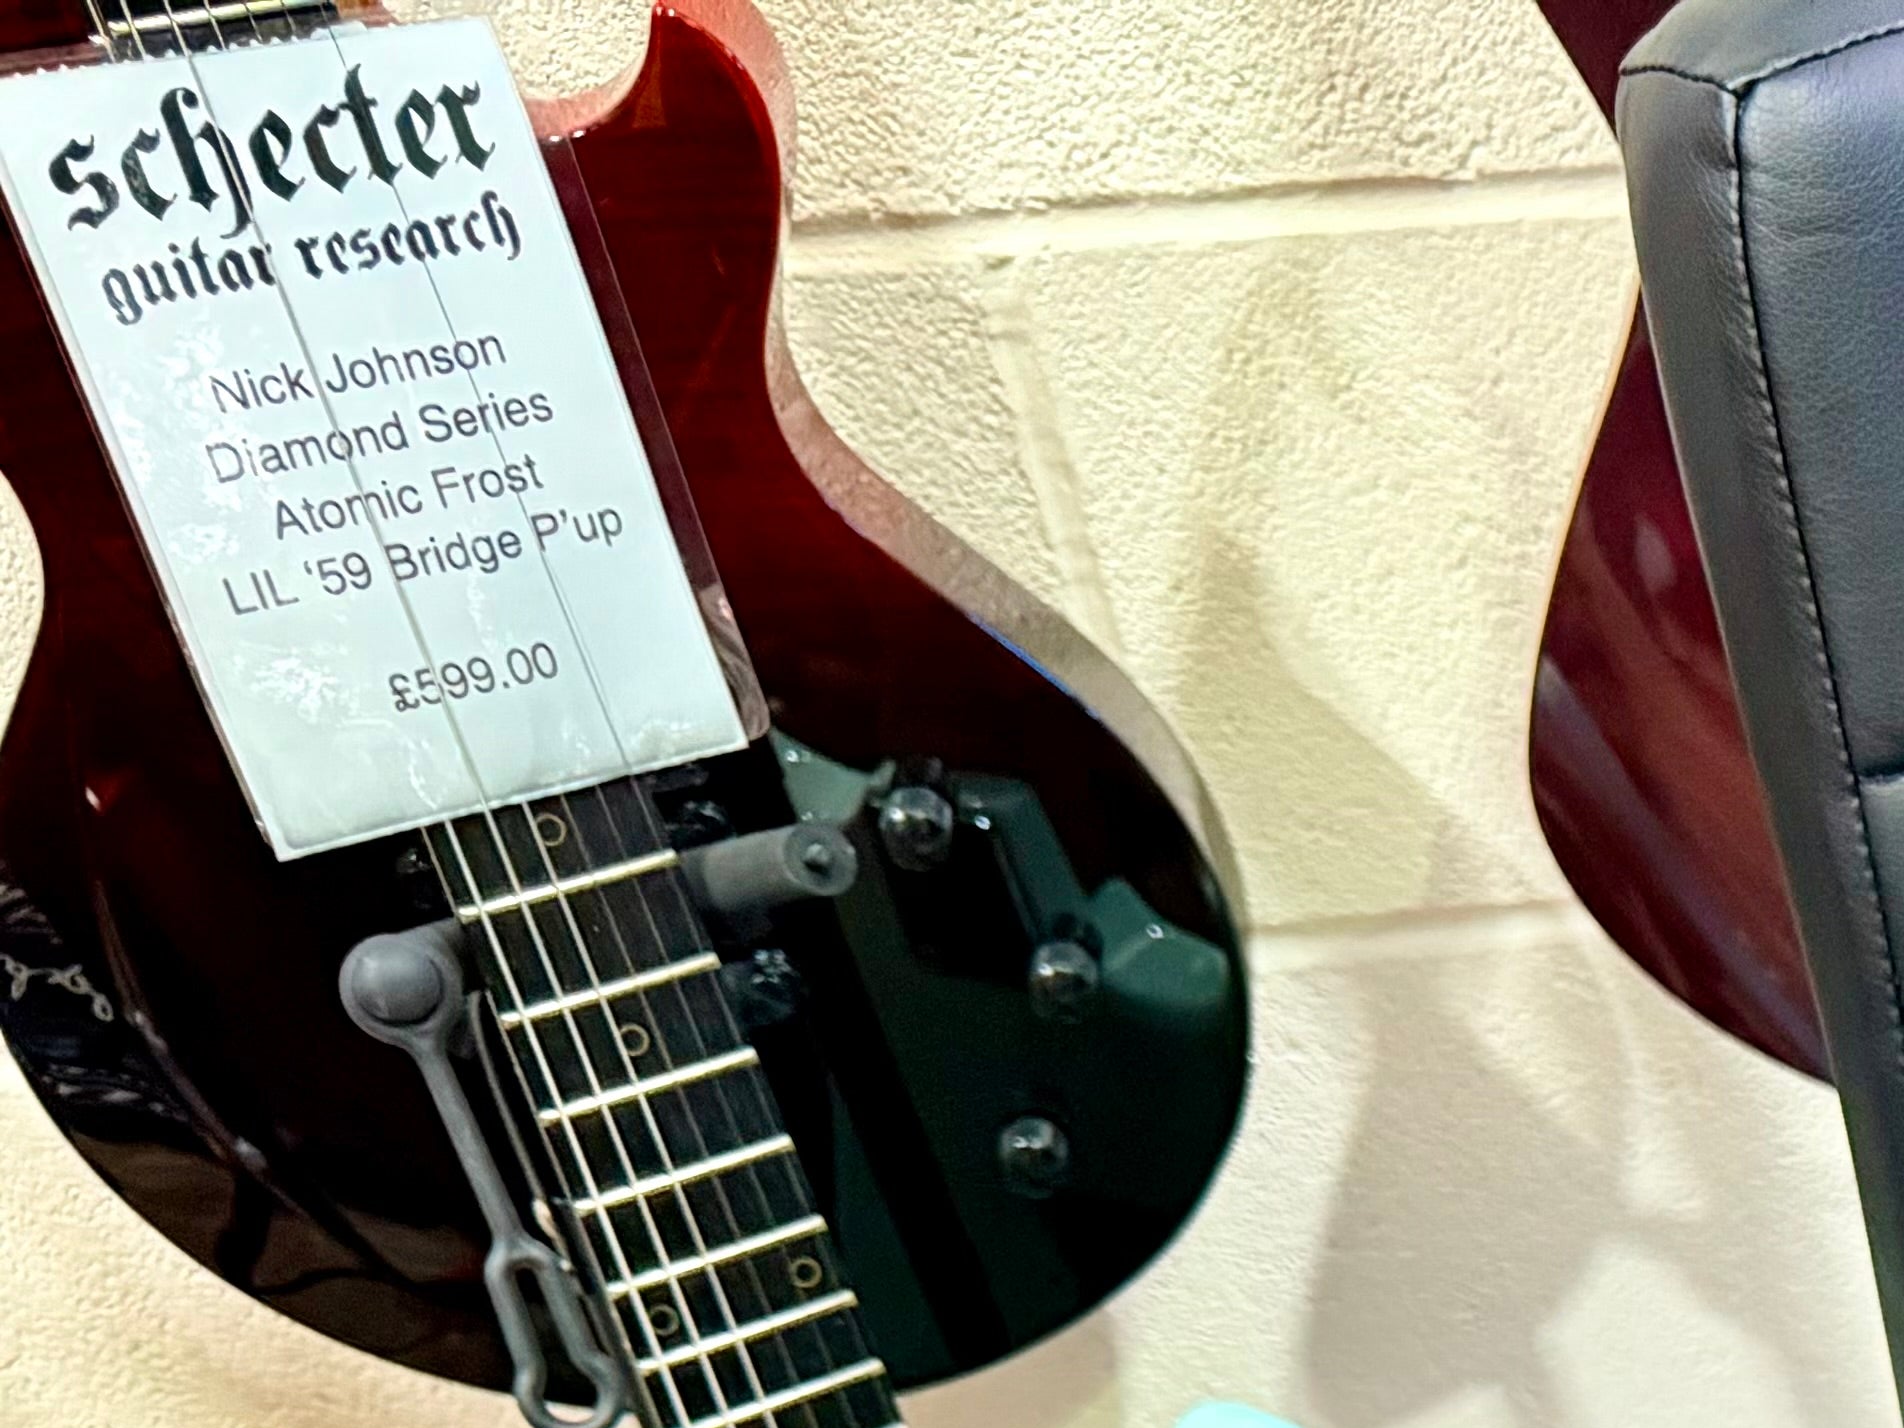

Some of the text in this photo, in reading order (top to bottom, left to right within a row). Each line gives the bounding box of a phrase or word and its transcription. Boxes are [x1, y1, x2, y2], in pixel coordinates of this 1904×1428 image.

[101, 190, 522, 326] guitar research
[209, 331, 507, 414] Nick Johnson
[205, 390, 555, 486] Diamond Series
[275, 452, 545, 541] Atomic Frost
[223, 571, 299, 617] LIL
[389, 528, 522, 583] Bridge
[390, 642, 560, 712] £599.00
